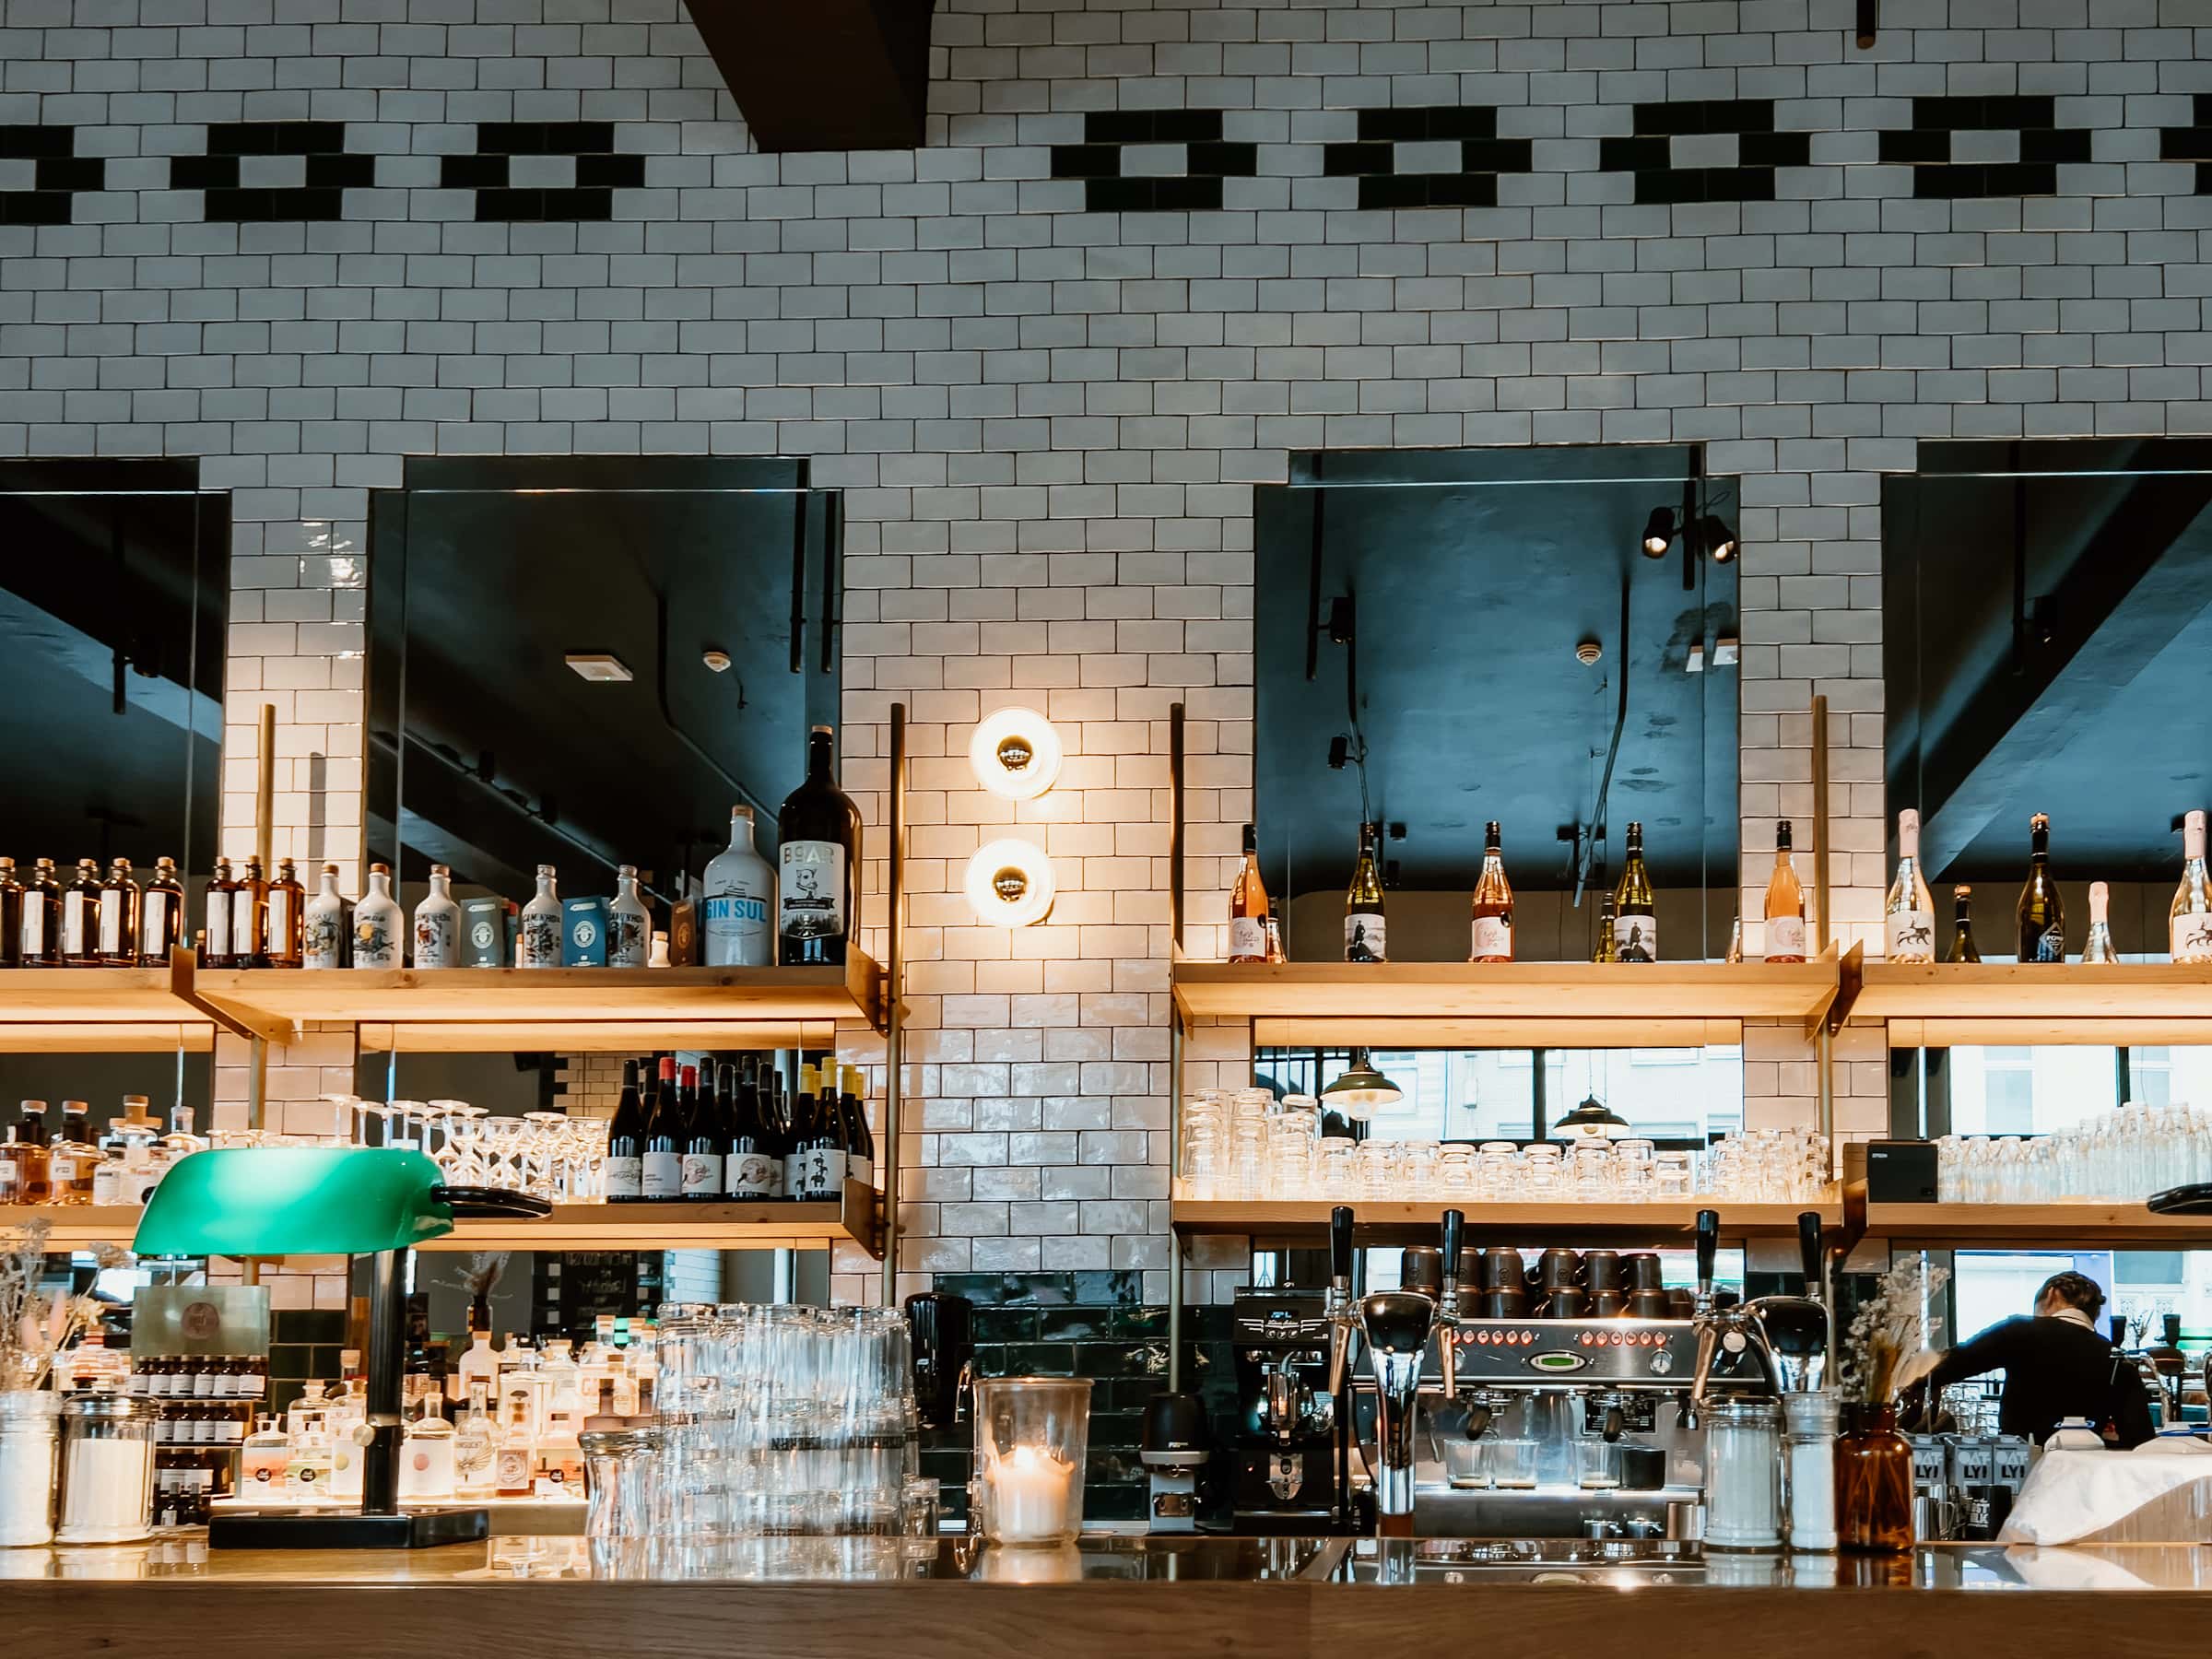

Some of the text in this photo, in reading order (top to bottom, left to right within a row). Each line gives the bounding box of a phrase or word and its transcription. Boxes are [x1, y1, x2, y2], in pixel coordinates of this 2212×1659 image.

[706, 899, 730, 919] GIN
[734, 900, 767, 923] SUL
[1915, 1465, 1939, 1478] LY!
[1963, 1465, 1988, 1478] LY!
[2001, 1465, 2025, 1478] LY!
